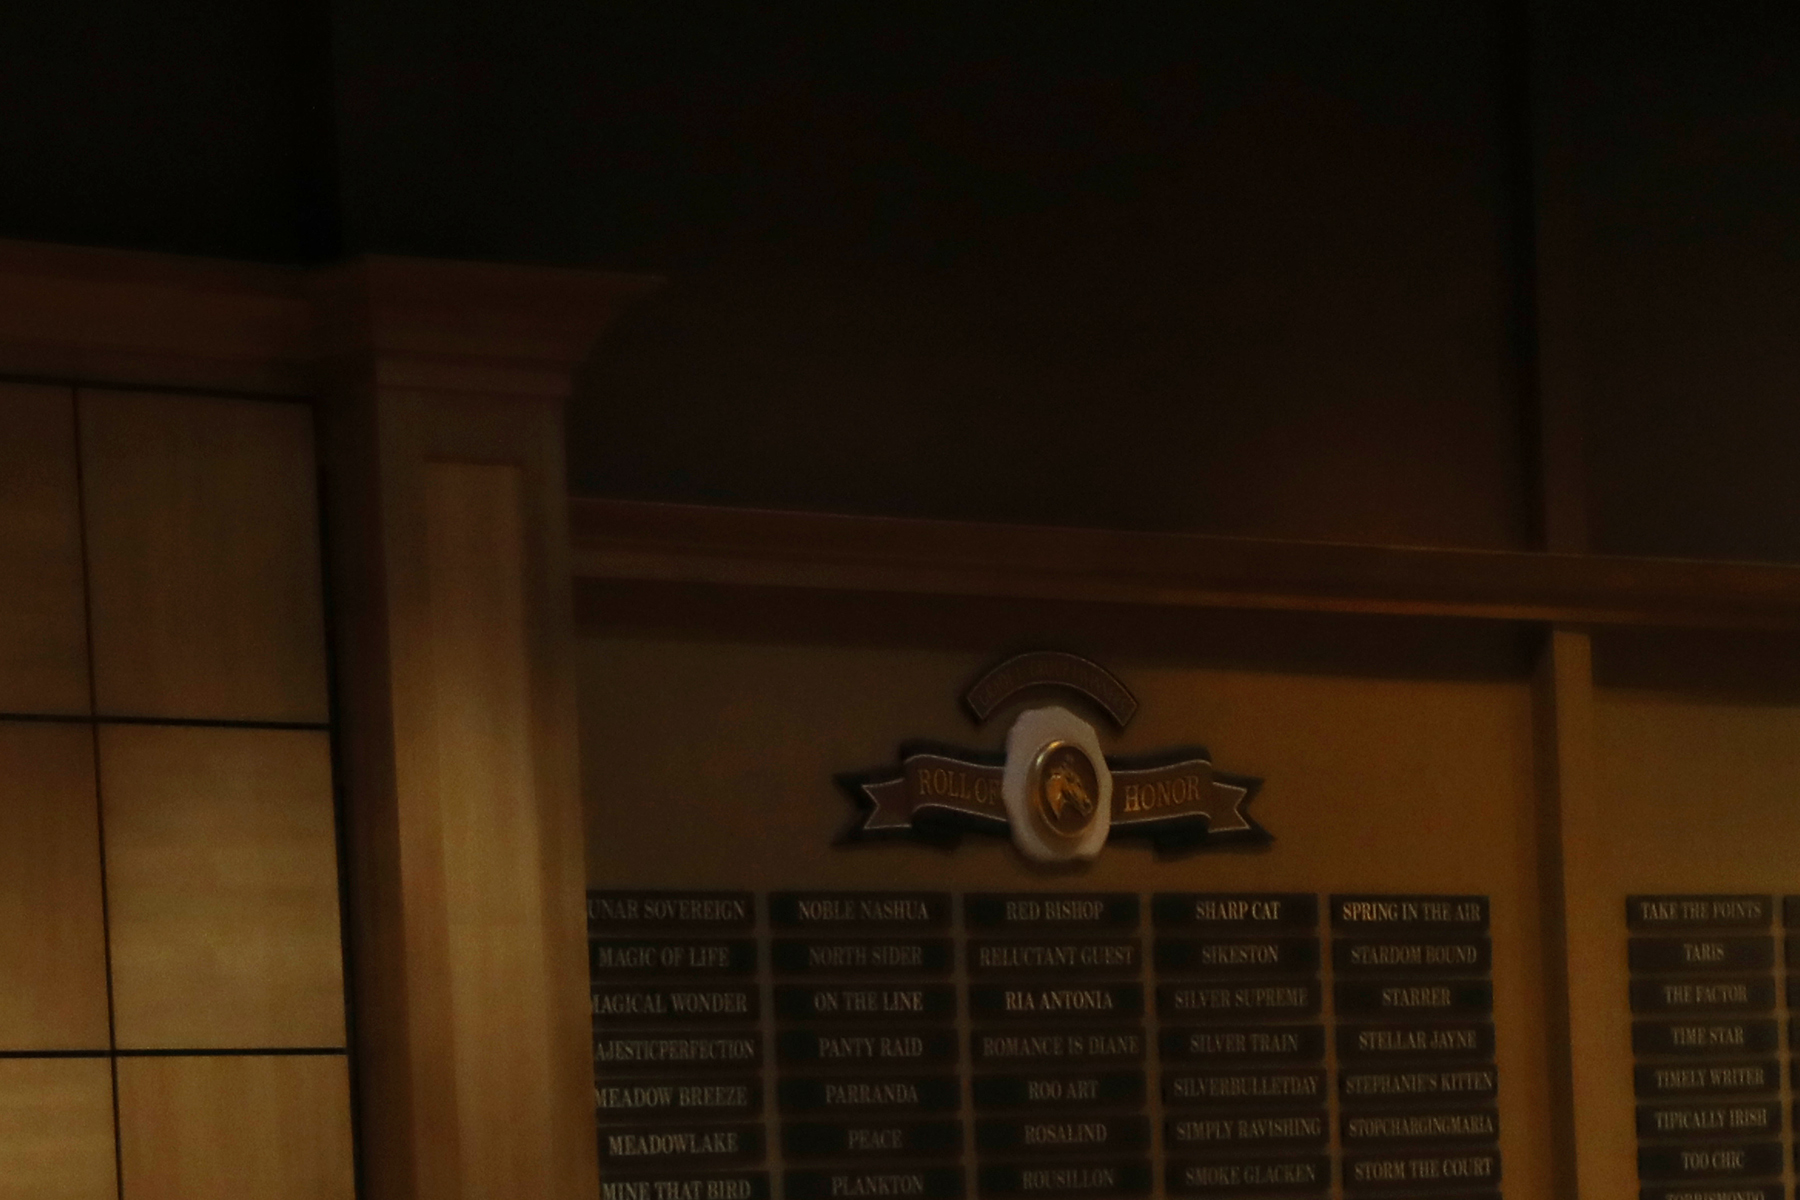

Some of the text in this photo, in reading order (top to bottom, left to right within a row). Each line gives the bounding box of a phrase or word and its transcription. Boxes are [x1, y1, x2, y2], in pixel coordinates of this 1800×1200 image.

[917, 768, 1200, 814] ROLL OF HONOR
[588, 900, 745, 920] UNAR SOVEREIGN
[799, 901, 929, 921] NOBLE NASHUA
[1006, 901, 1104, 920] RED BISHOP
[1196, 901, 1281, 921] SHARP CAT
[1342, 902, 1481, 921] SPRING IN THE AIR
[599, 947, 729, 968] MAGIC OF LIFE
[809, 947, 922, 967] NORTH SIDER
[1202, 944, 1279, 964] SIKESTON
[1351, 945, 1477, 965] STARDOM BOUND
[670, 992, 747, 1012] WONDER
[814, 991, 923, 1011] ON THE LINE
[1006, 991, 1113, 1011] RIA ANTONIA
[1665, 985, 1748, 1004] THE FACTOR
[1191, 1033, 1299, 1053] SILVER TRAIN
[1359, 1030, 1476, 1050] STELLAR JAYNE
[1672, 1026, 1744, 1045] TIME STAR
[597, 1039, 754, 1061] AJESTICPERFECTION
[819, 1037, 923, 1058] PANTY RAID
[1655, 1068, 1764, 1088] TIMELY WRITER
[595, 1086, 748, 1108] MEADOW BREEZE
[1028, 1079, 1099, 1100] ROO ART
[849, 1129, 902, 1149] PEACE
[1025, 1123, 1107, 1144] ROSALIND
[1176, 1121, 1234, 1141] SIMPLY
[609, 1132, 739, 1156] MEADOWLAKE
[1354, 1157, 1493, 1181] STORM THE COURT
[1682, 1151, 1744, 1170] TOO CHIC
[832, 1174, 925, 1196] PLANKTON
[1186, 1164, 1316, 1187] SMOKE GLACKEN
[654, 1181, 701, 1200] THAT
[707, 1180, 752, 1200] BIRD
